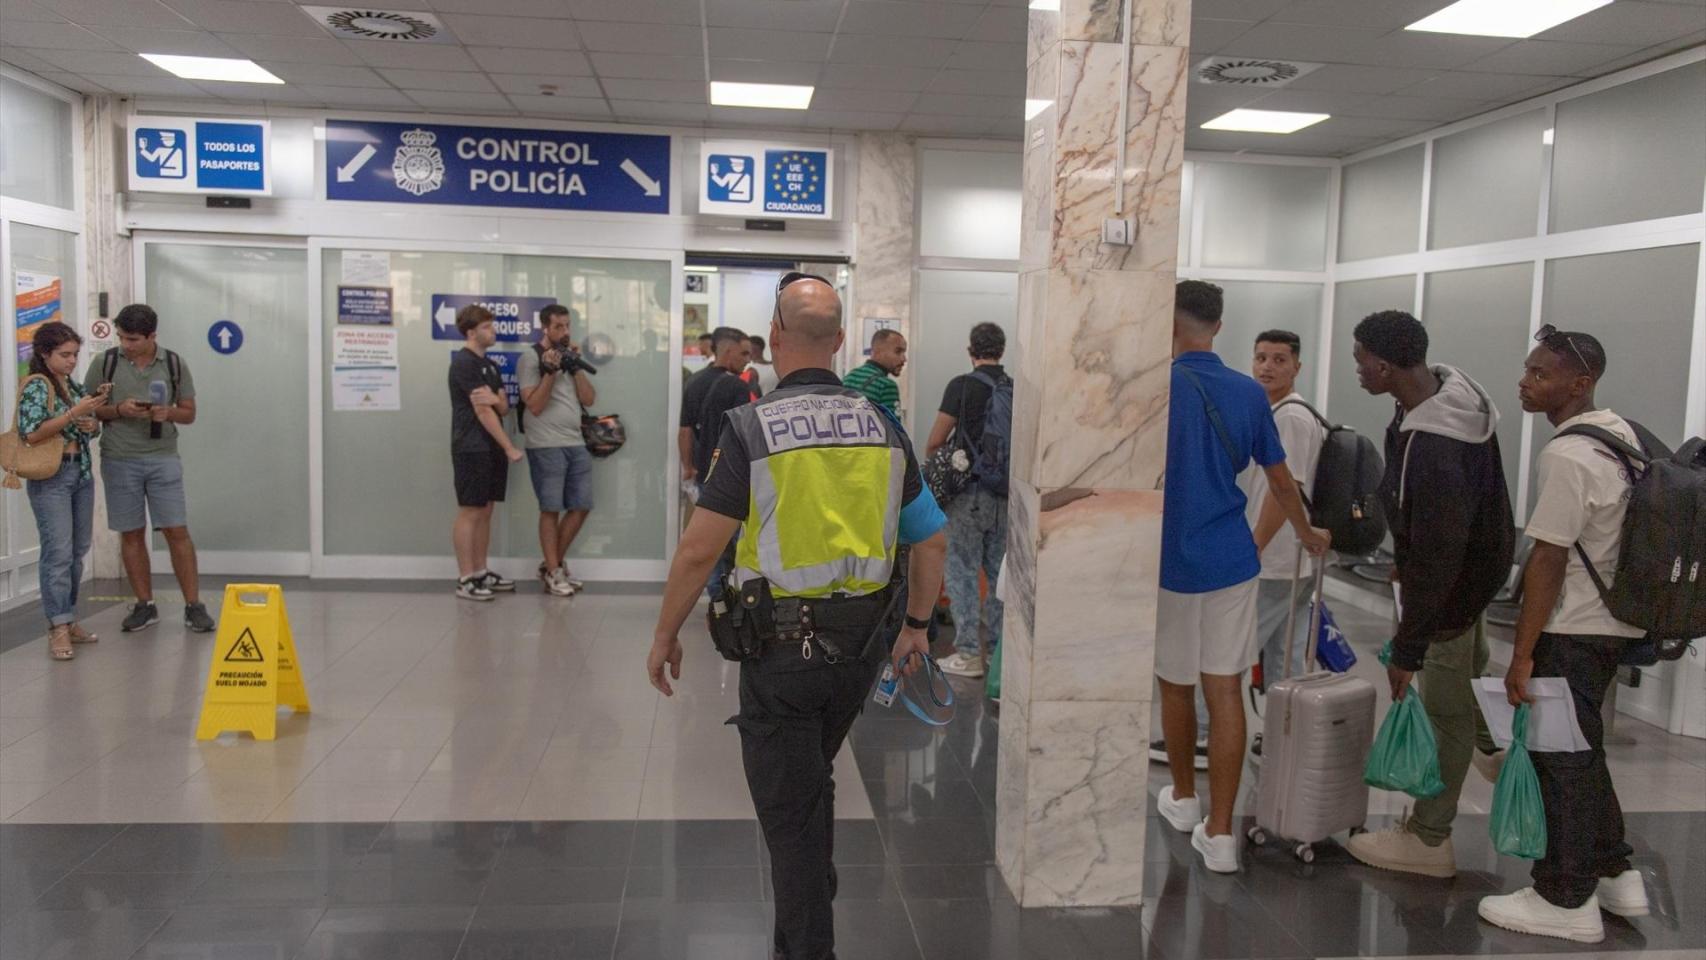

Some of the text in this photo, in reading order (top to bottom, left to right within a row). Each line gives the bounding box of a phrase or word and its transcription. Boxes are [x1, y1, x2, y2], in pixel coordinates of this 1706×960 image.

[203, 142, 256, 153] TODOS LOS
[456, 137, 599, 165] CONTROL
[200, 159, 260, 171] PASAPORTES
[789, 163, 802, 172] UE
[469, 167, 587, 196] POLICÍA
[786, 173, 804, 182] EEE
[788, 183, 802, 191] CH
[766, 201, 823, 212] CIUDADANOS
[493, 321, 531, 335] RQUES
[767, 414, 882, 445] POLICIA
[215, 679, 238, 687] SUELO
